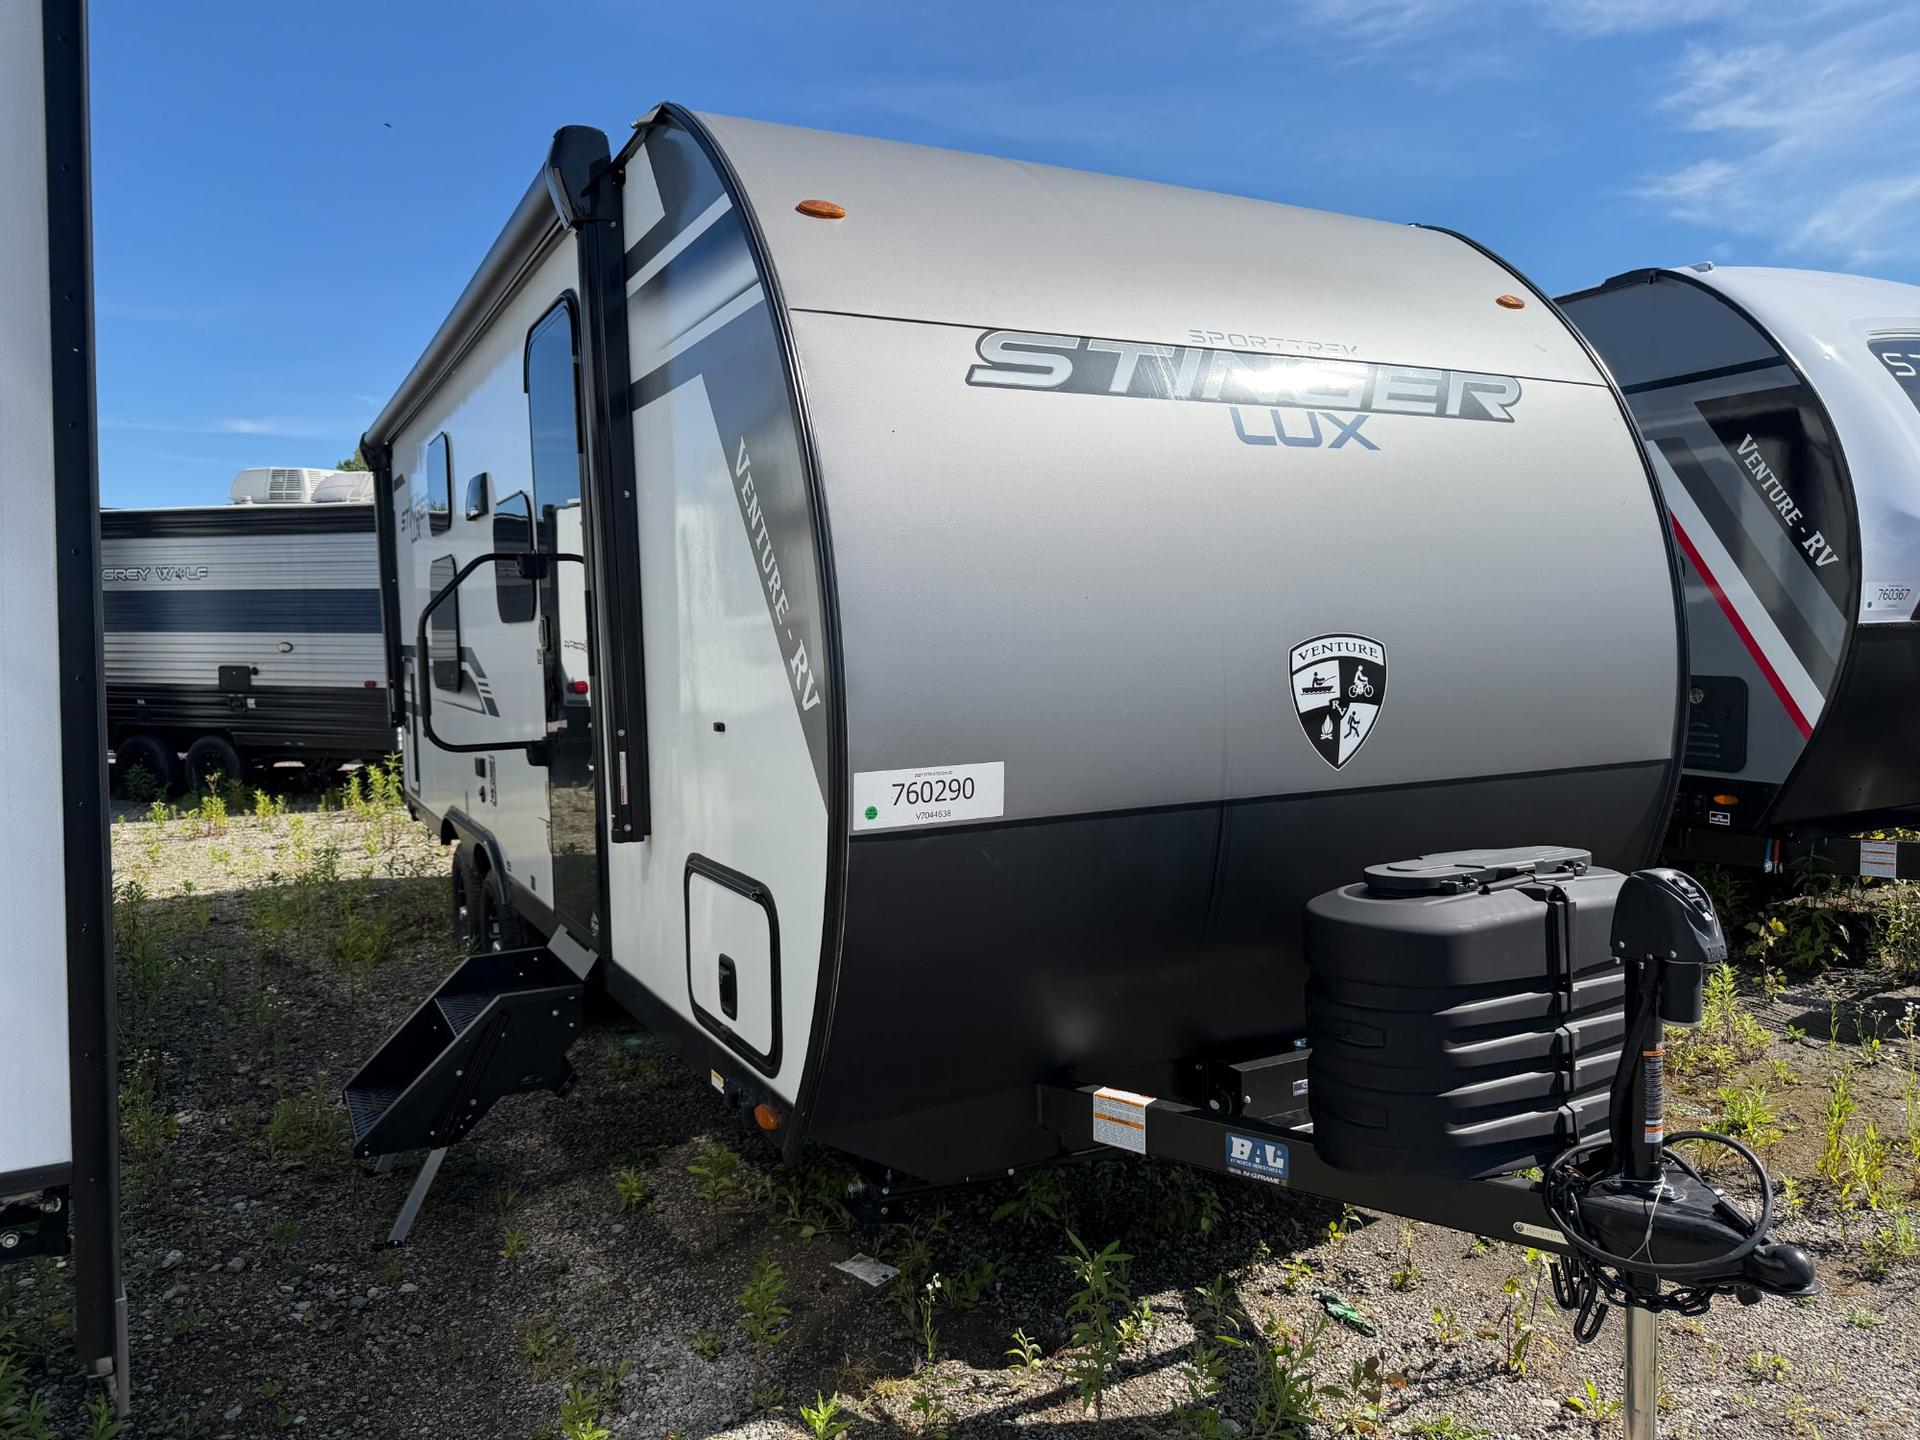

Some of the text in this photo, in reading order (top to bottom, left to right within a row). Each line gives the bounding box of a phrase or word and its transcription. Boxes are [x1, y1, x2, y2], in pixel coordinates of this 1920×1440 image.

[1188, 329, 1360, 356] SPORTTREK
[965, 329, 1522, 423] STINGER
[1229, 406, 1382, 450] LUX
[1737, 433, 1803, 526] VENTURE
[1802, 530, 1839, 566] RV
[102, 567, 151, 581] GREY
[735, 435, 789, 625] VENTURE
[790, 639, 821, 711] RV
[1878, 588, 1911, 600] 760367
[1298, 642, 1378, 660] VENTURE
[892, 777, 975, 806] 760290
